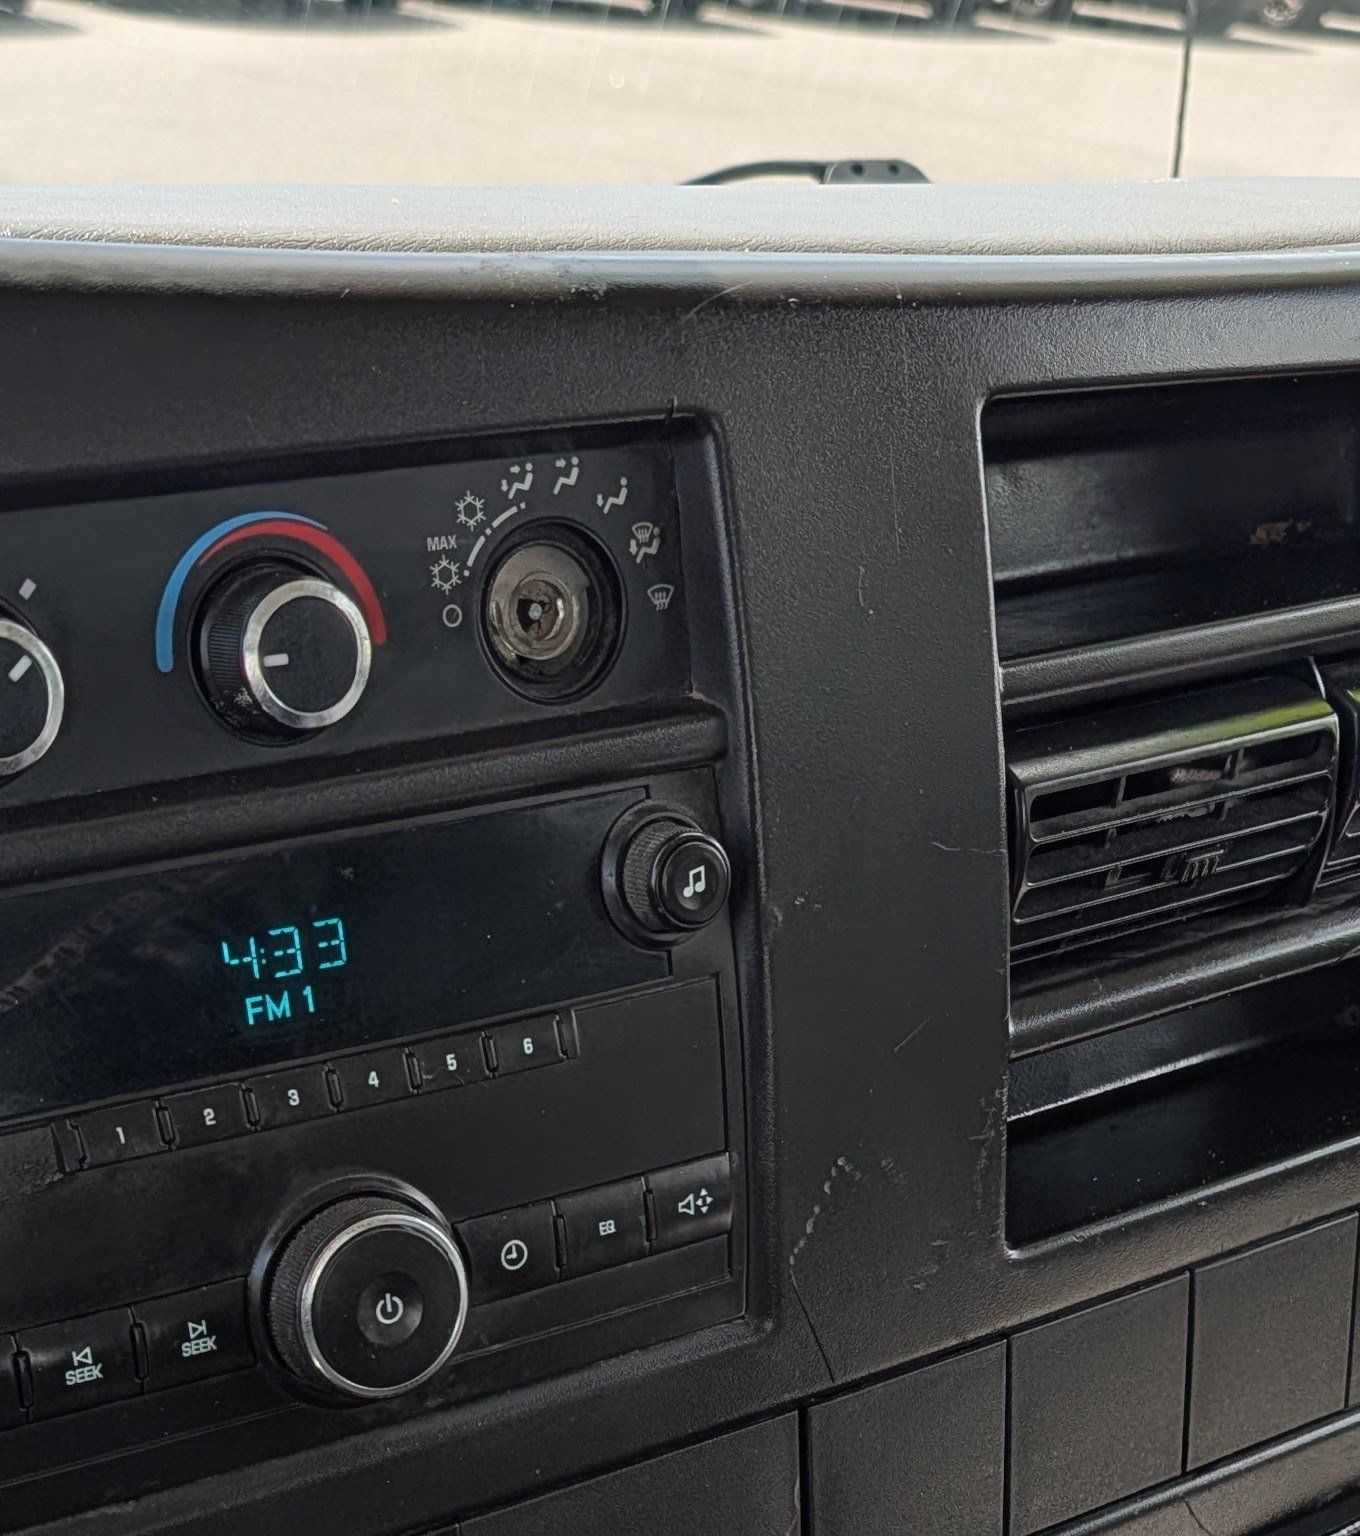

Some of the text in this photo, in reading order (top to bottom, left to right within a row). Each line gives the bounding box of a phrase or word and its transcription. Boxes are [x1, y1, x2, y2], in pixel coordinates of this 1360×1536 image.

[426, 534, 457, 552] MAX
[221, 917, 347, 980] 4:33
[244, 985, 315, 1026] FM 1
[523, 1037, 534, 1055] 6
[446, 1053, 458, 1071] 5
[368, 1071, 380, 1088] 4
[287, 1088, 300, 1107] 3
[203, 1108, 216, 1126] 2
[115, 1126, 126, 1144] 1
[181, 1334, 218, 1358] SEEK
[65, 1362, 103, 1386] SEEK
